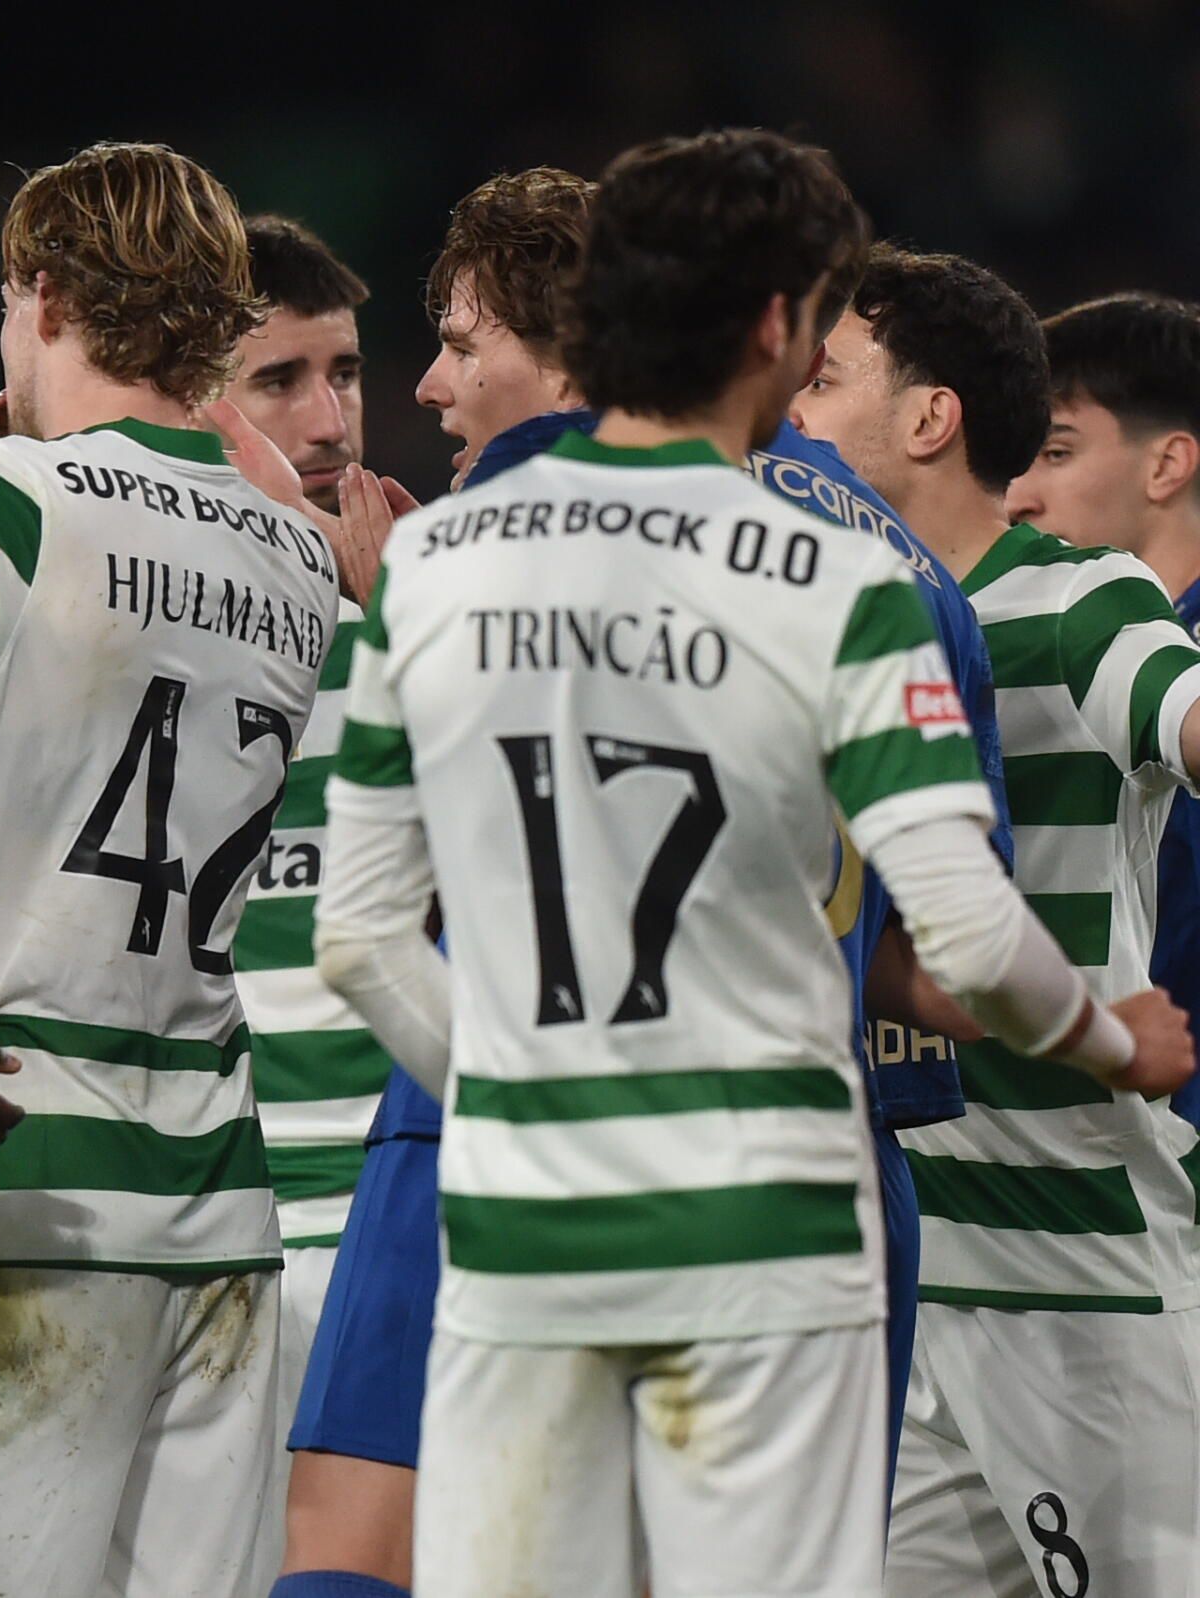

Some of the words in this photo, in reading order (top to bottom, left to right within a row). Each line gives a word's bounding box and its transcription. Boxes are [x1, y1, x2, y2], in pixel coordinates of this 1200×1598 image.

[56, 461, 186, 519] SUPER
[188, 488, 290, 552] BOCK
[420, 502, 551, 558] SUPER
[563, 501, 708, 554] BOCK
[726, 519, 820, 587] 0.0
[107, 552, 324, 670] HJULMAND
[467, 607, 729, 689] TRINCÃO
[59, 675, 293, 976] 42
[258, 835, 321, 890] ta
[496, 734, 728, 1026] 17
[1026, 1491, 1090, 1598] 8
